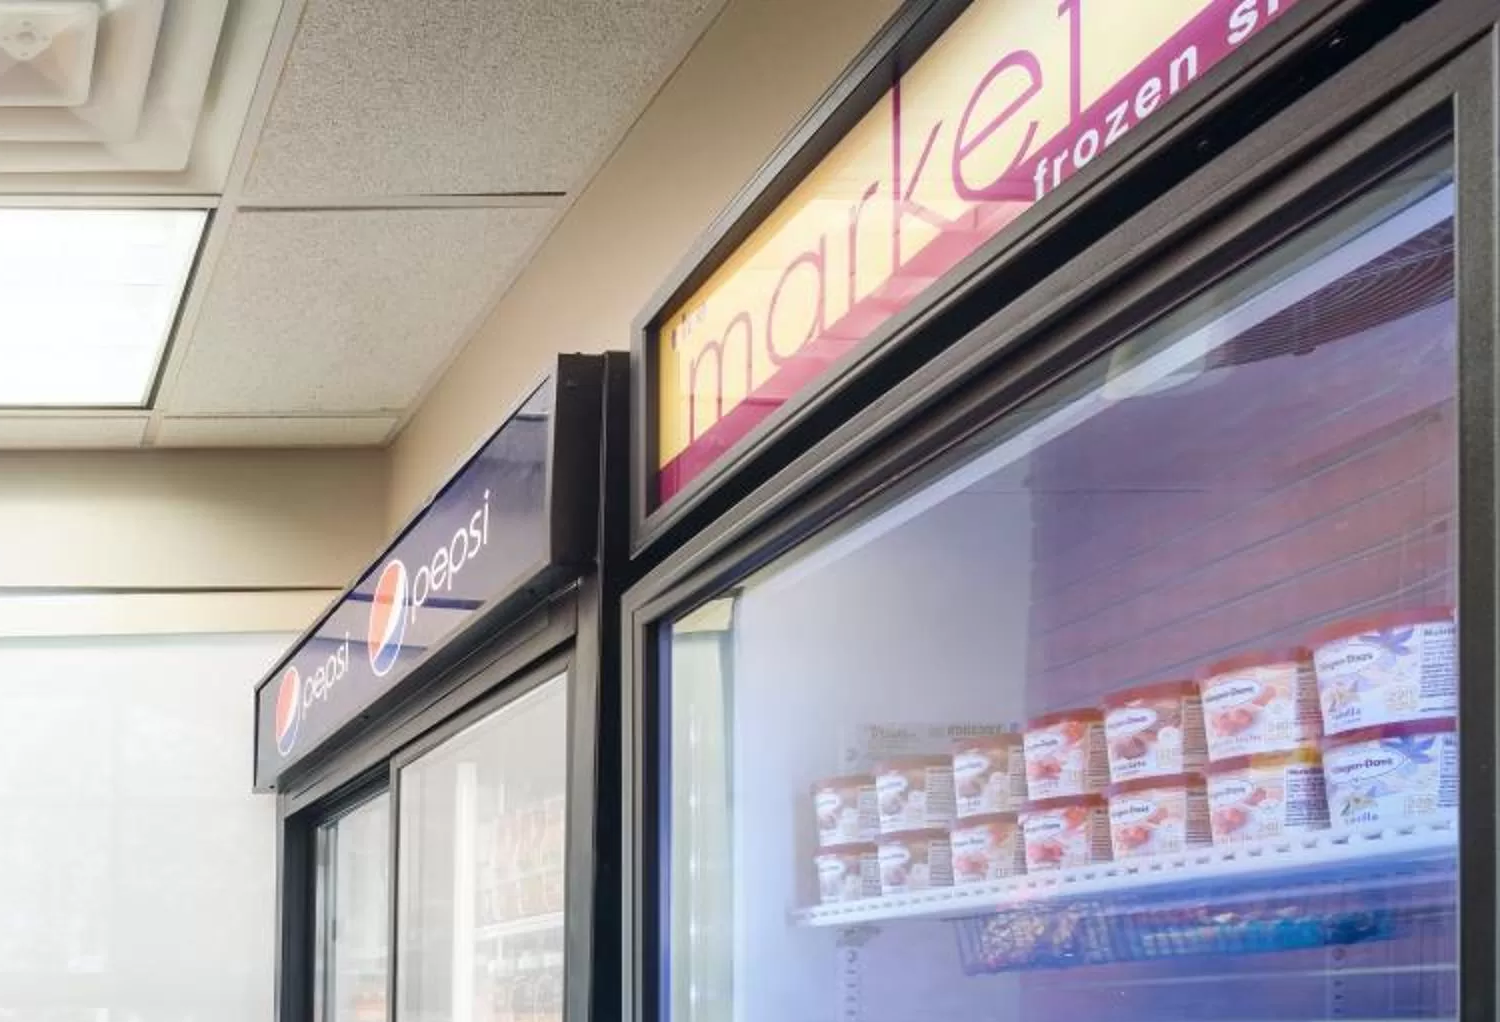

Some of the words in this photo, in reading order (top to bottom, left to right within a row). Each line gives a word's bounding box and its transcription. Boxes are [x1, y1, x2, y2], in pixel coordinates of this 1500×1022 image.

[1032, 44, 1198, 202] frozen
[411, 488, 489, 625] pepsi
[301, 631, 350, 721] pepsi
